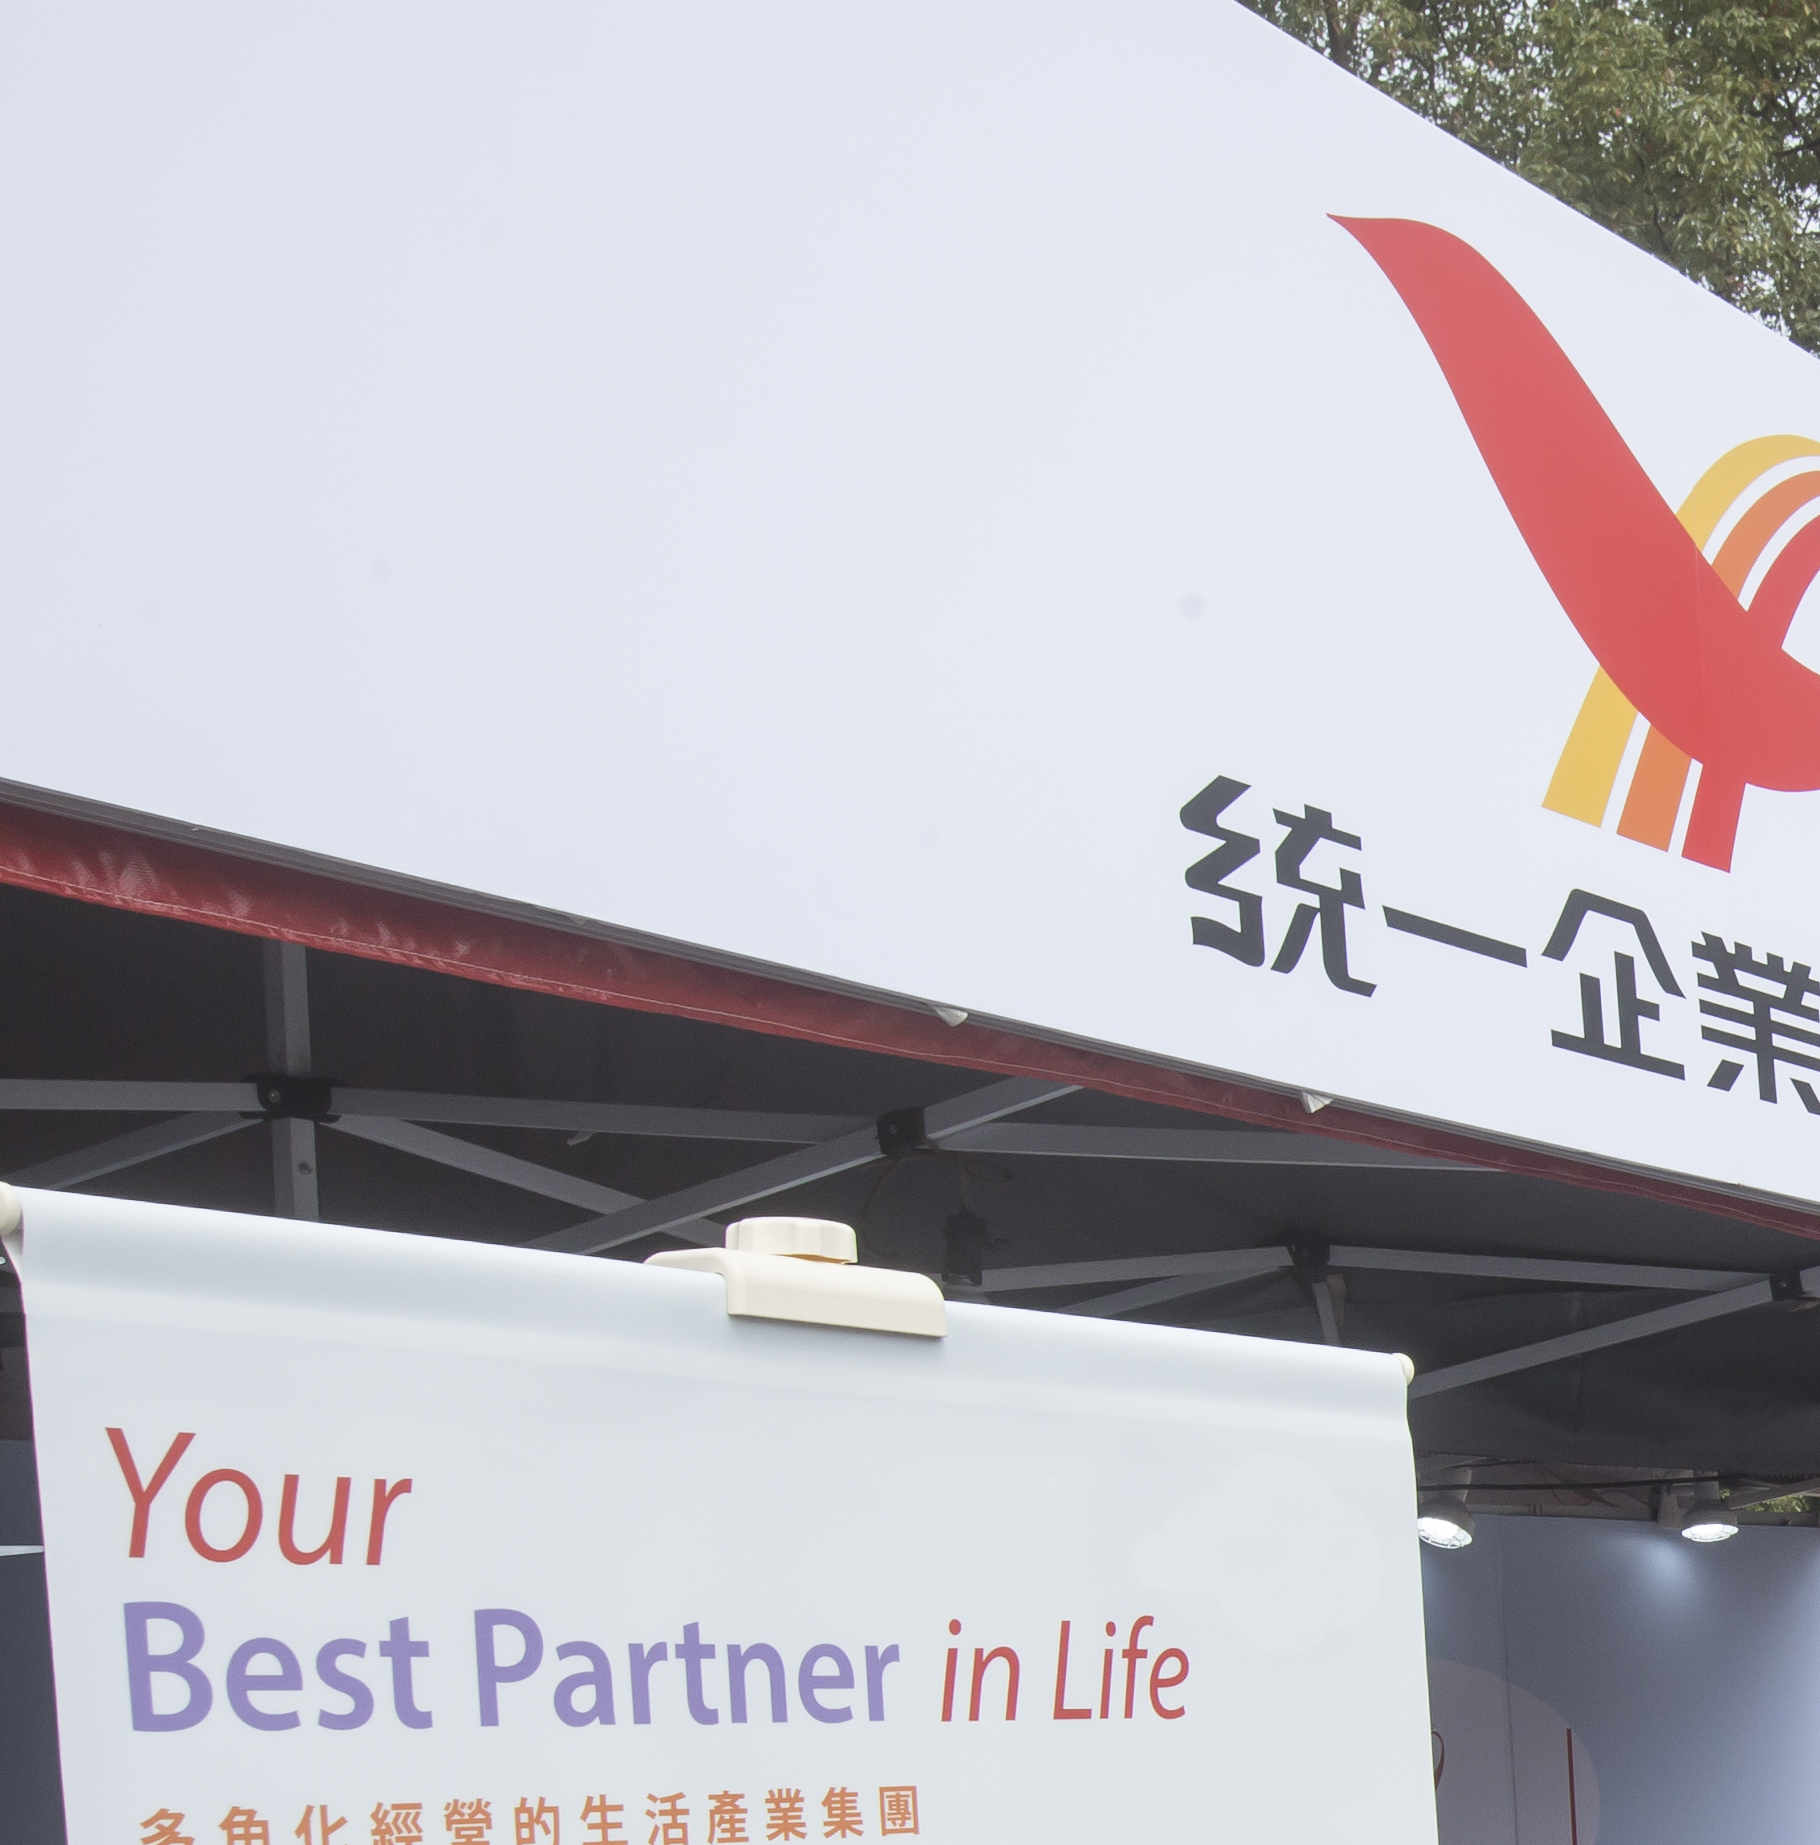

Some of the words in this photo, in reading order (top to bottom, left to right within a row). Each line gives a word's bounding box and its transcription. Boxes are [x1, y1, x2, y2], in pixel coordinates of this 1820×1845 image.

[104, 1426, 413, 1567] Your
[122, 1601, 434, 1733] Best
[472, 1607, 900, 1728] Partner
[940, 1618, 1022, 1723] in
[1051, 1614, 1190, 1722] Life
